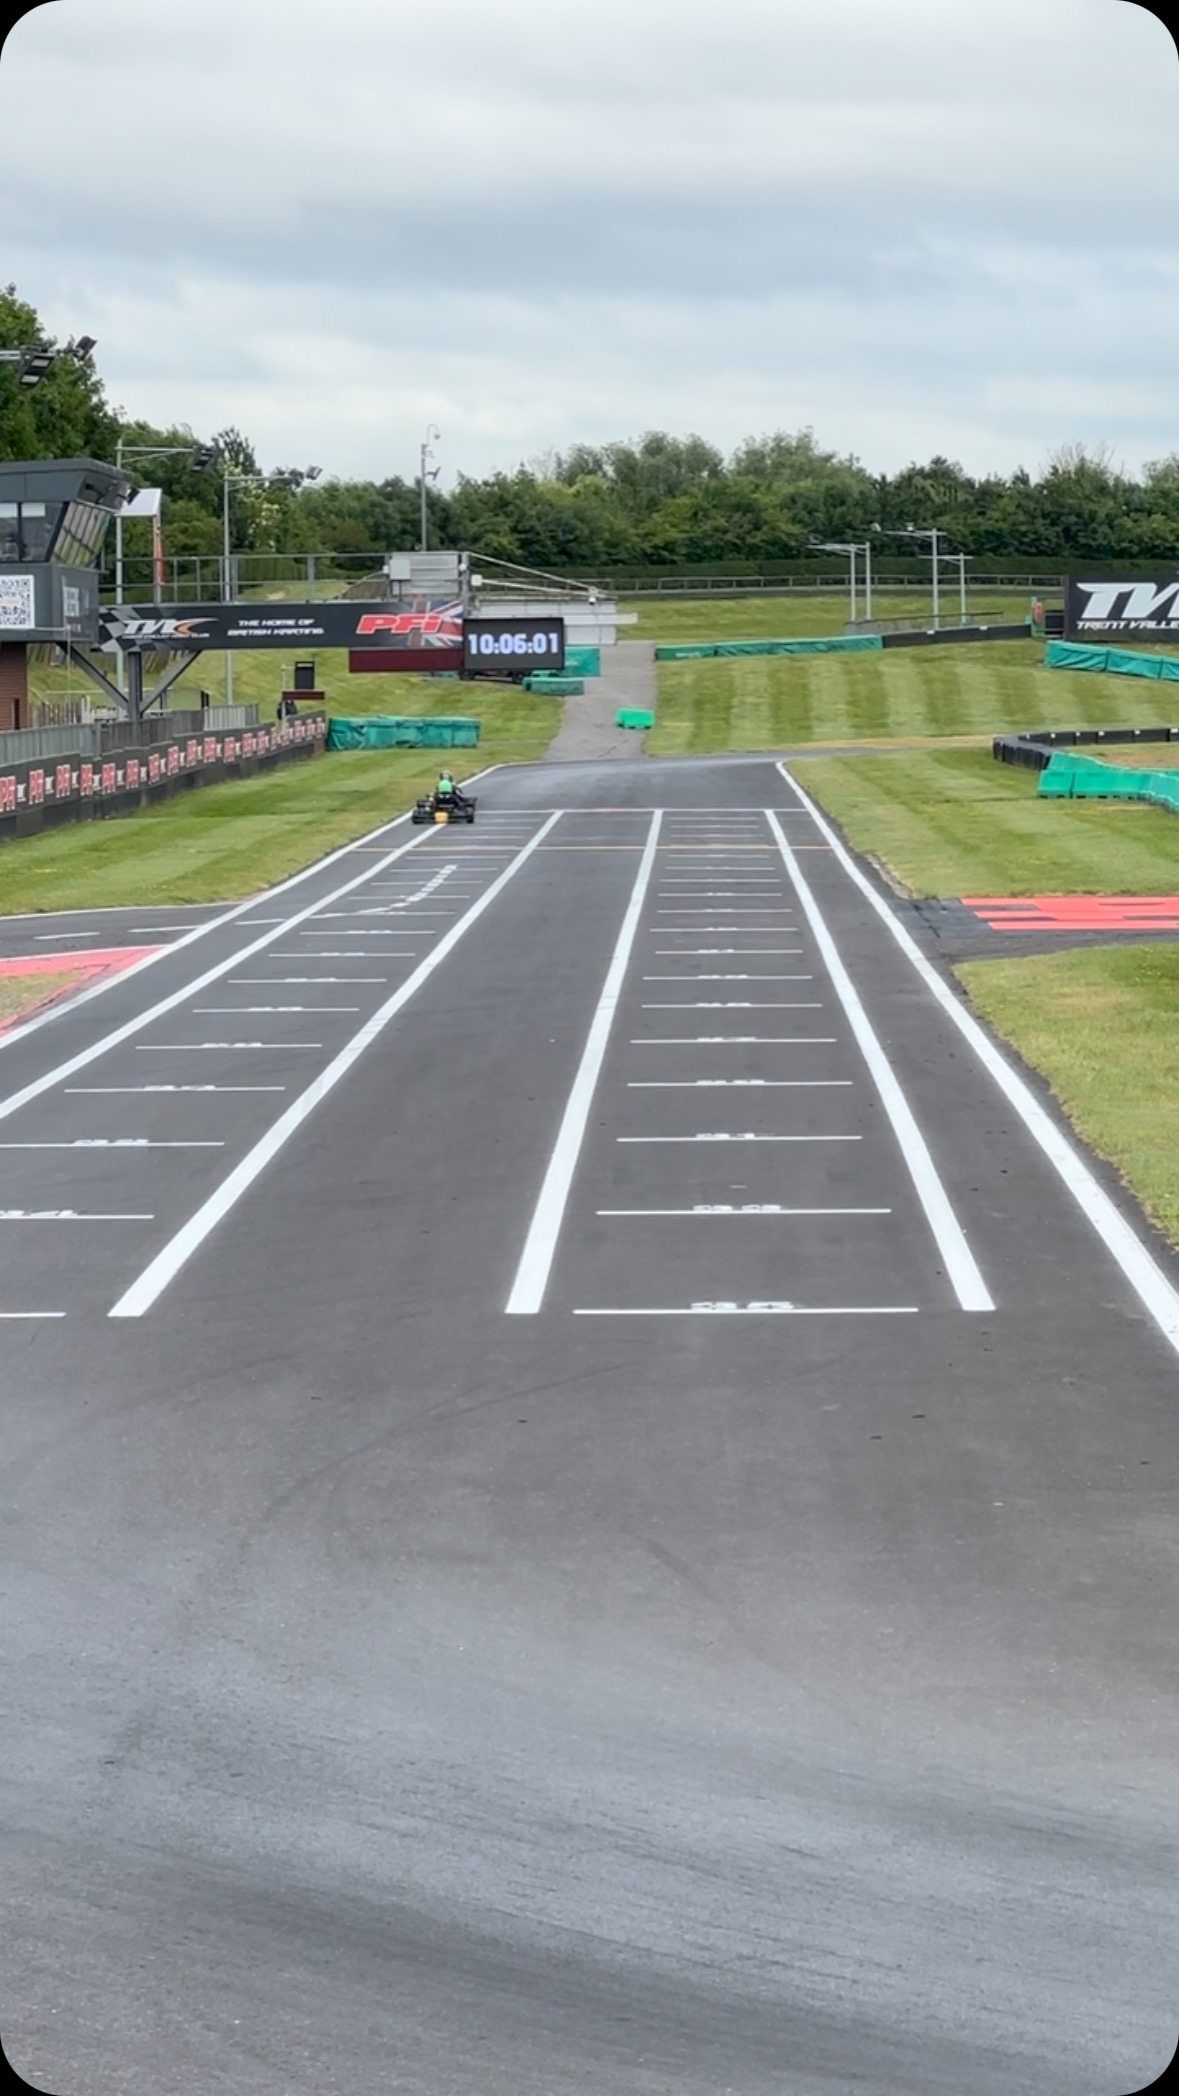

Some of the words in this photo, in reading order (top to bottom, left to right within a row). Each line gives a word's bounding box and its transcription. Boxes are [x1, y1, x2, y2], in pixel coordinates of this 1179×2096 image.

[1076, 582, 1179, 618] TV
[238, 619, 259, 627] THE
[298, 618, 315, 626] OF
[1076, 620, 1127, 630] TRENT
[273, 627, 325, 636] KARTING
[468, 633, 559, 655] 10:06:01
